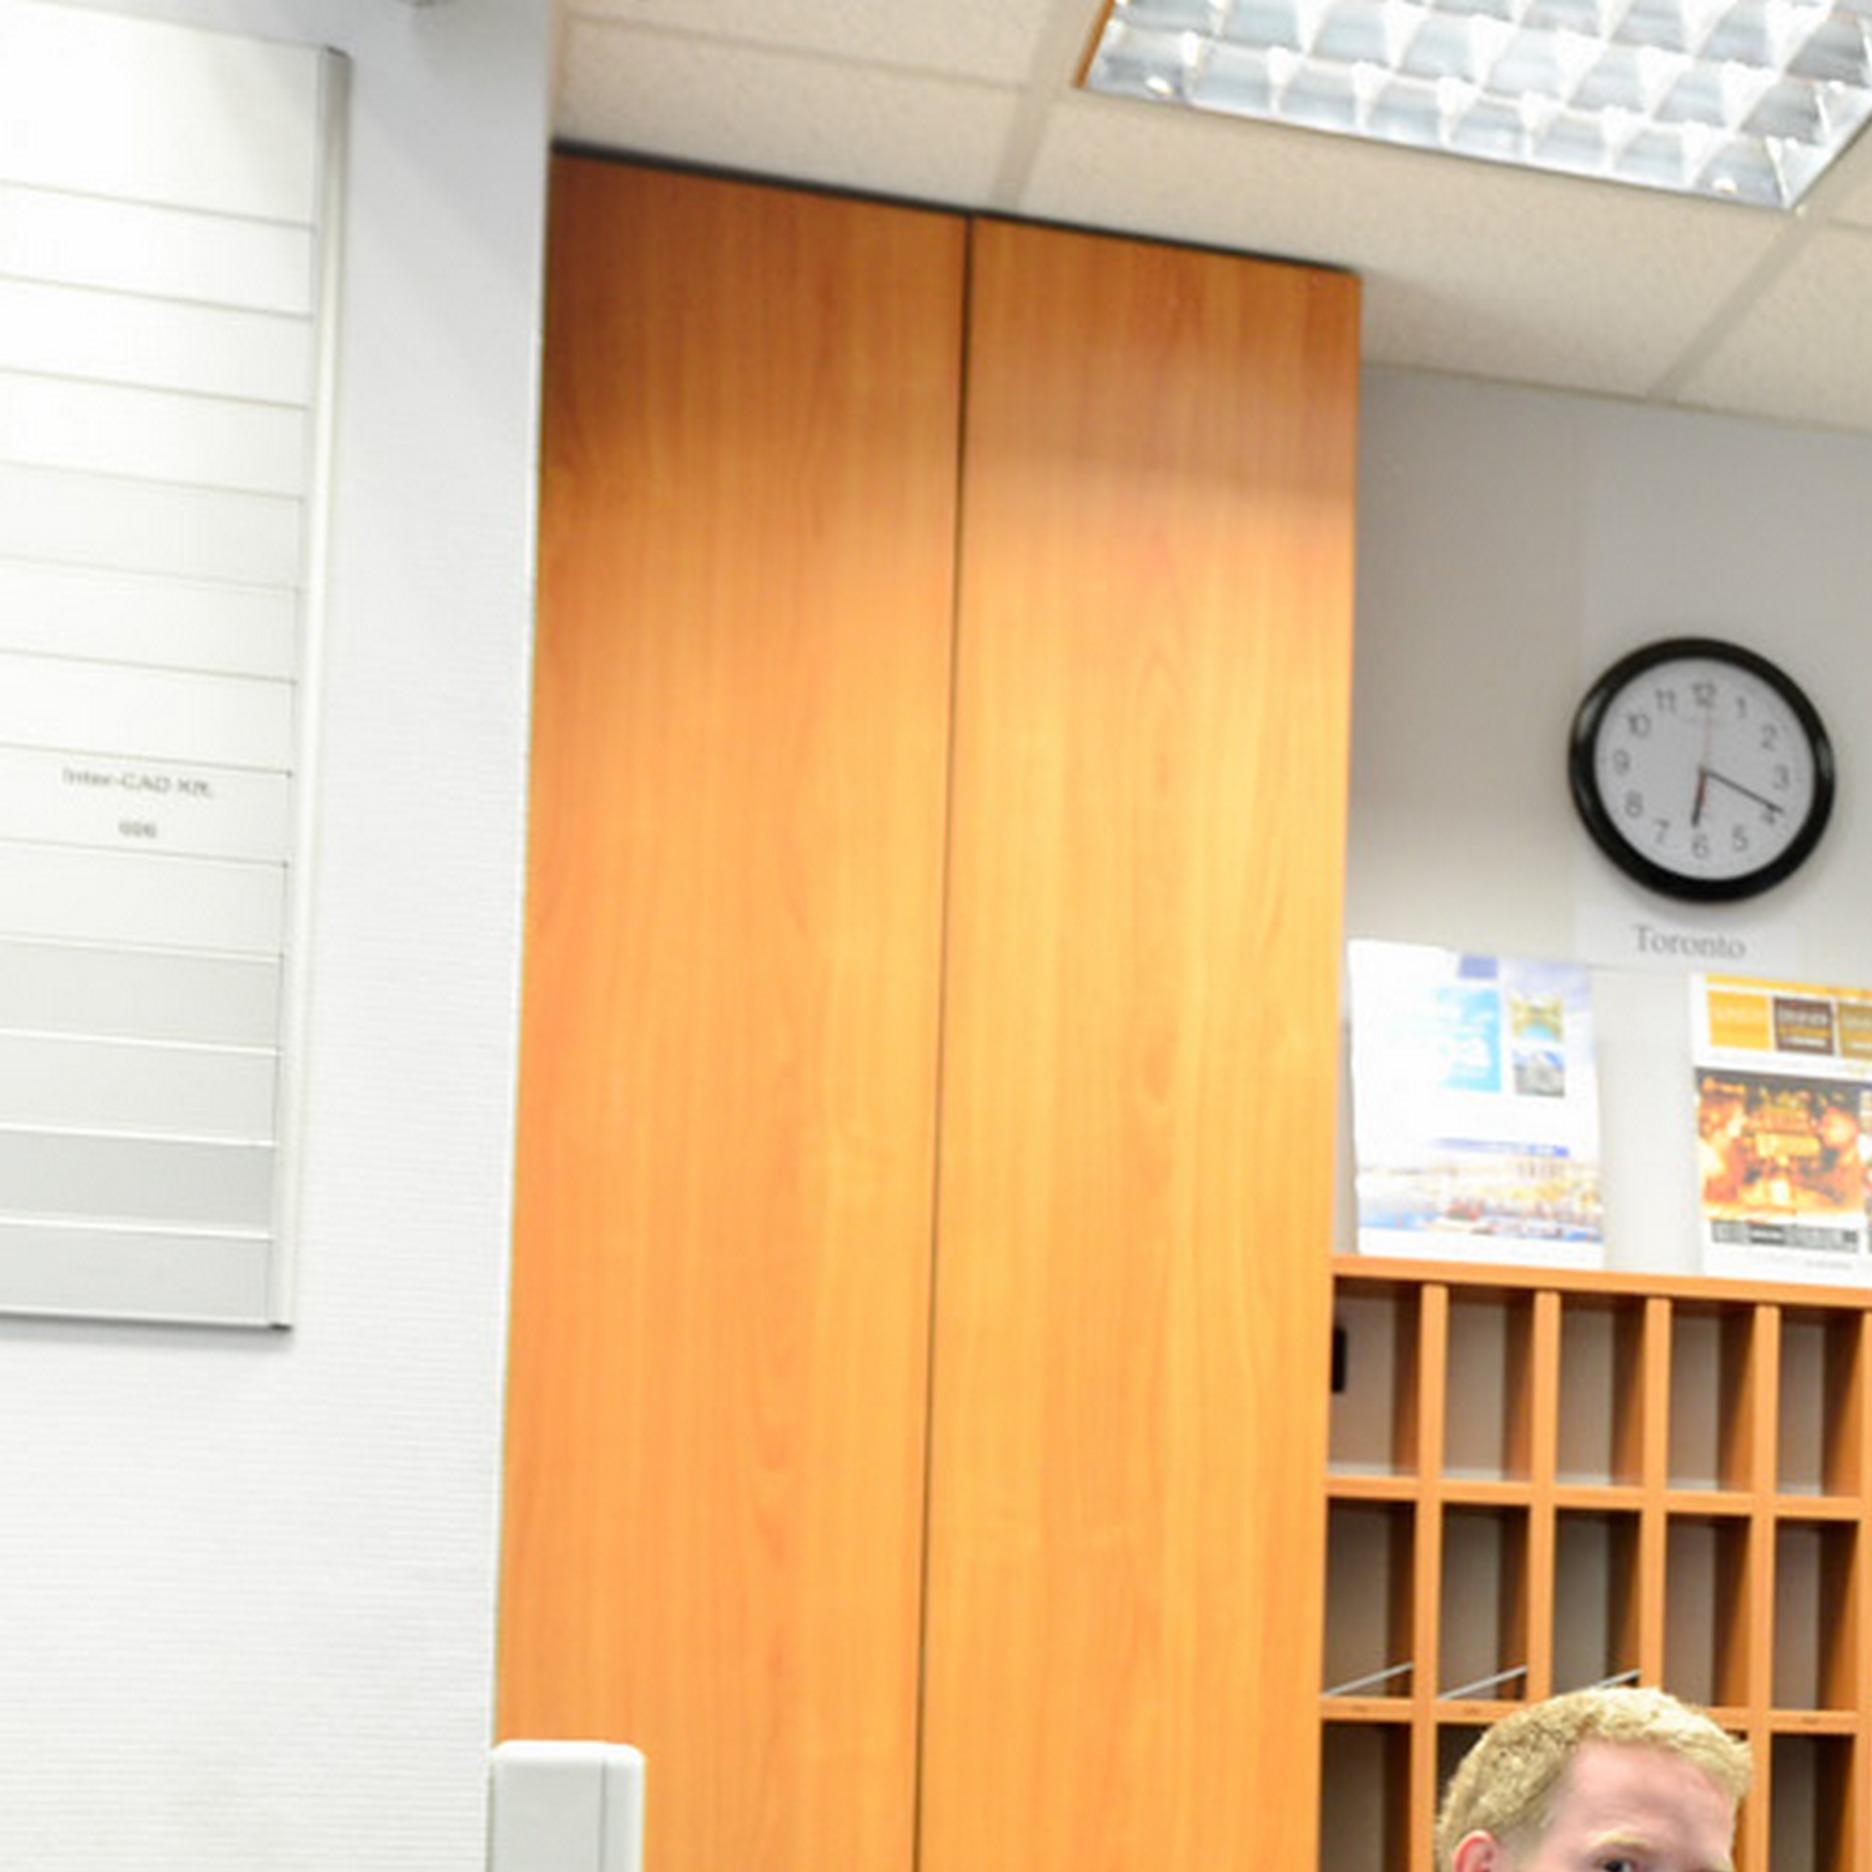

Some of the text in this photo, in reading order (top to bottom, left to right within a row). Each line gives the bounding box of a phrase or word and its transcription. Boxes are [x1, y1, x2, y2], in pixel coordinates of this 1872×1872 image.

[1654, 688, 1677, 714] 11
[1691, 682, 1717, 710] 12
[1627, 713, 1650, 739] 10
[1761, 723, 1778, 750] 2
[1612, 750, 1630, 776] 9
[1772, 764, 1789, 791] 3
[1625, 790, 1643, 819] 8
[1652, 818, 1670, 845] 7
[1731, 825, 1748, 852] 5
[1691, 834, 1709, 860] 6
[1632, 922, 1748, 960] Toronto
